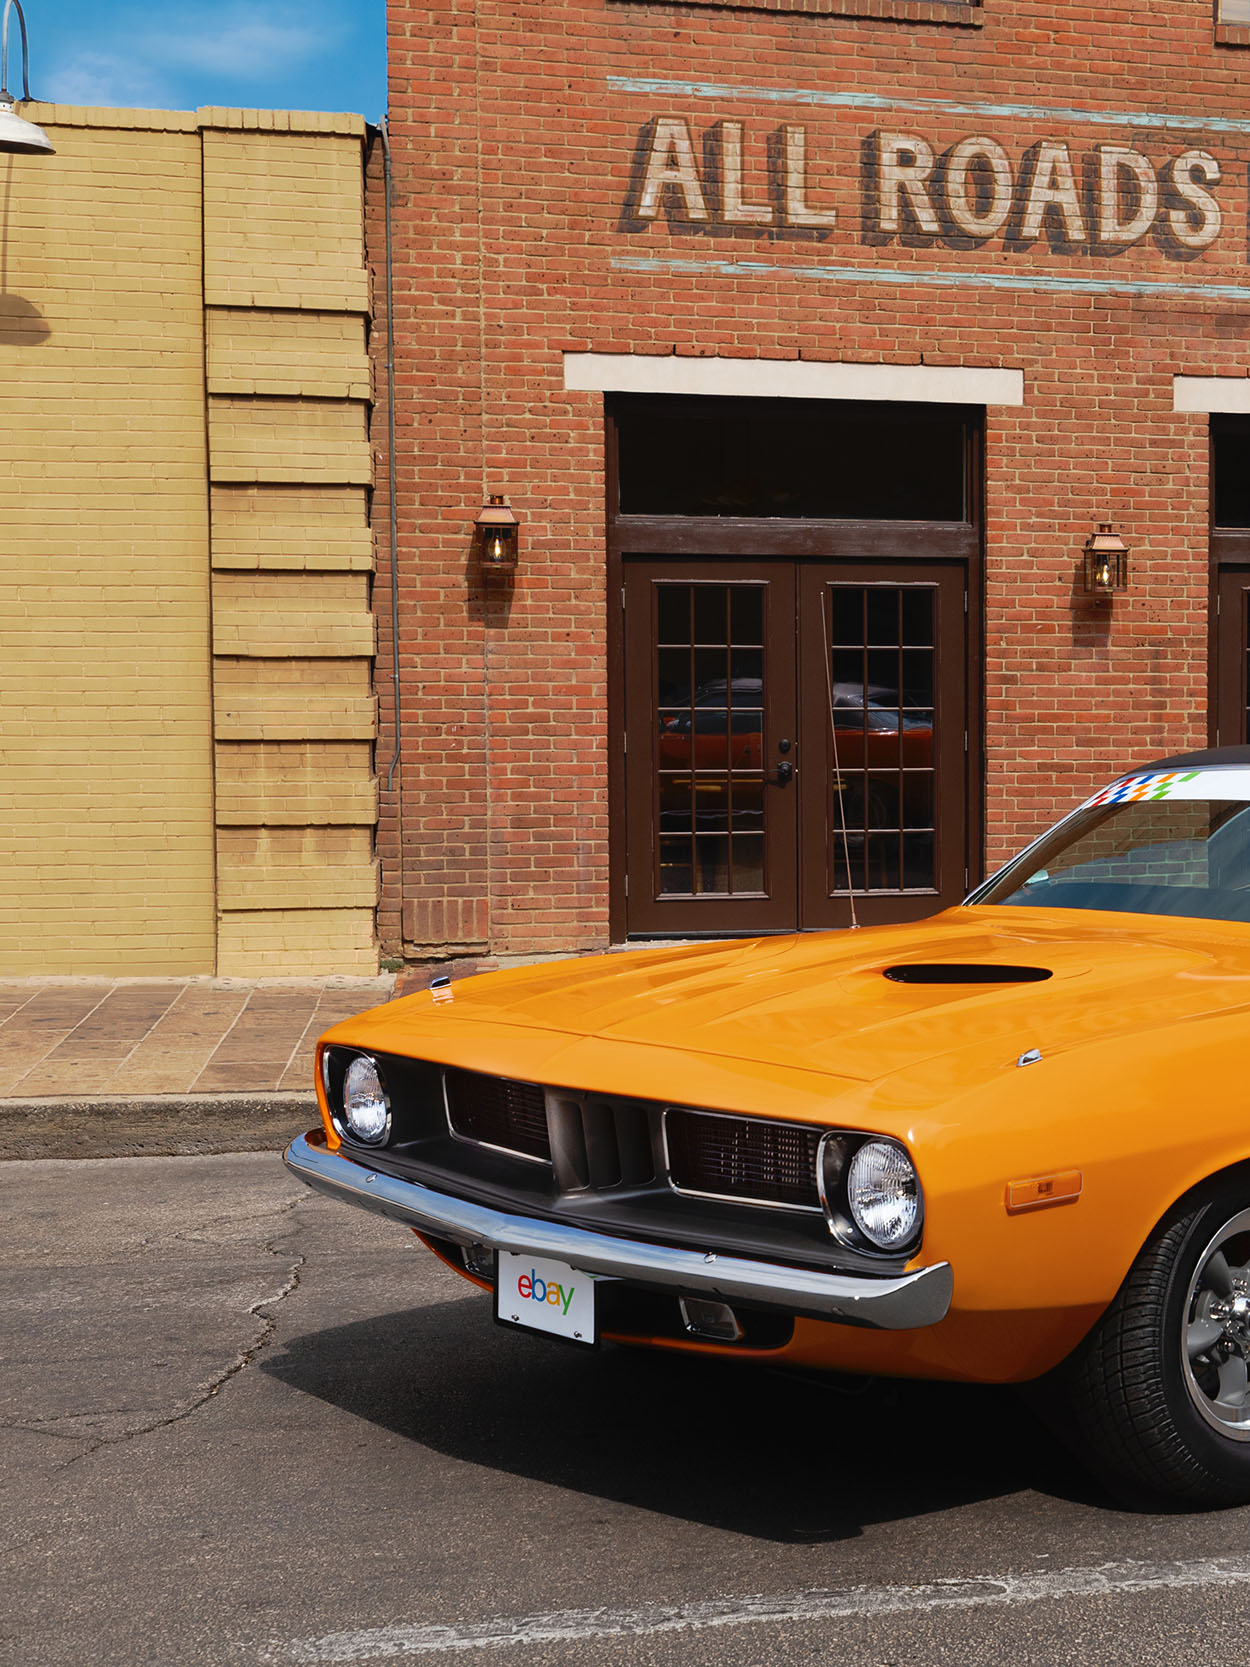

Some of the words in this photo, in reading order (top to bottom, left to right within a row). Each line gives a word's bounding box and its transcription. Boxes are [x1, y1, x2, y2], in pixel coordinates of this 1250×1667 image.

[635, 115, 838, 230] ALL
[874, 129, 1224, 249] ROADS
[517, 1268, 575, 1316] ebay
